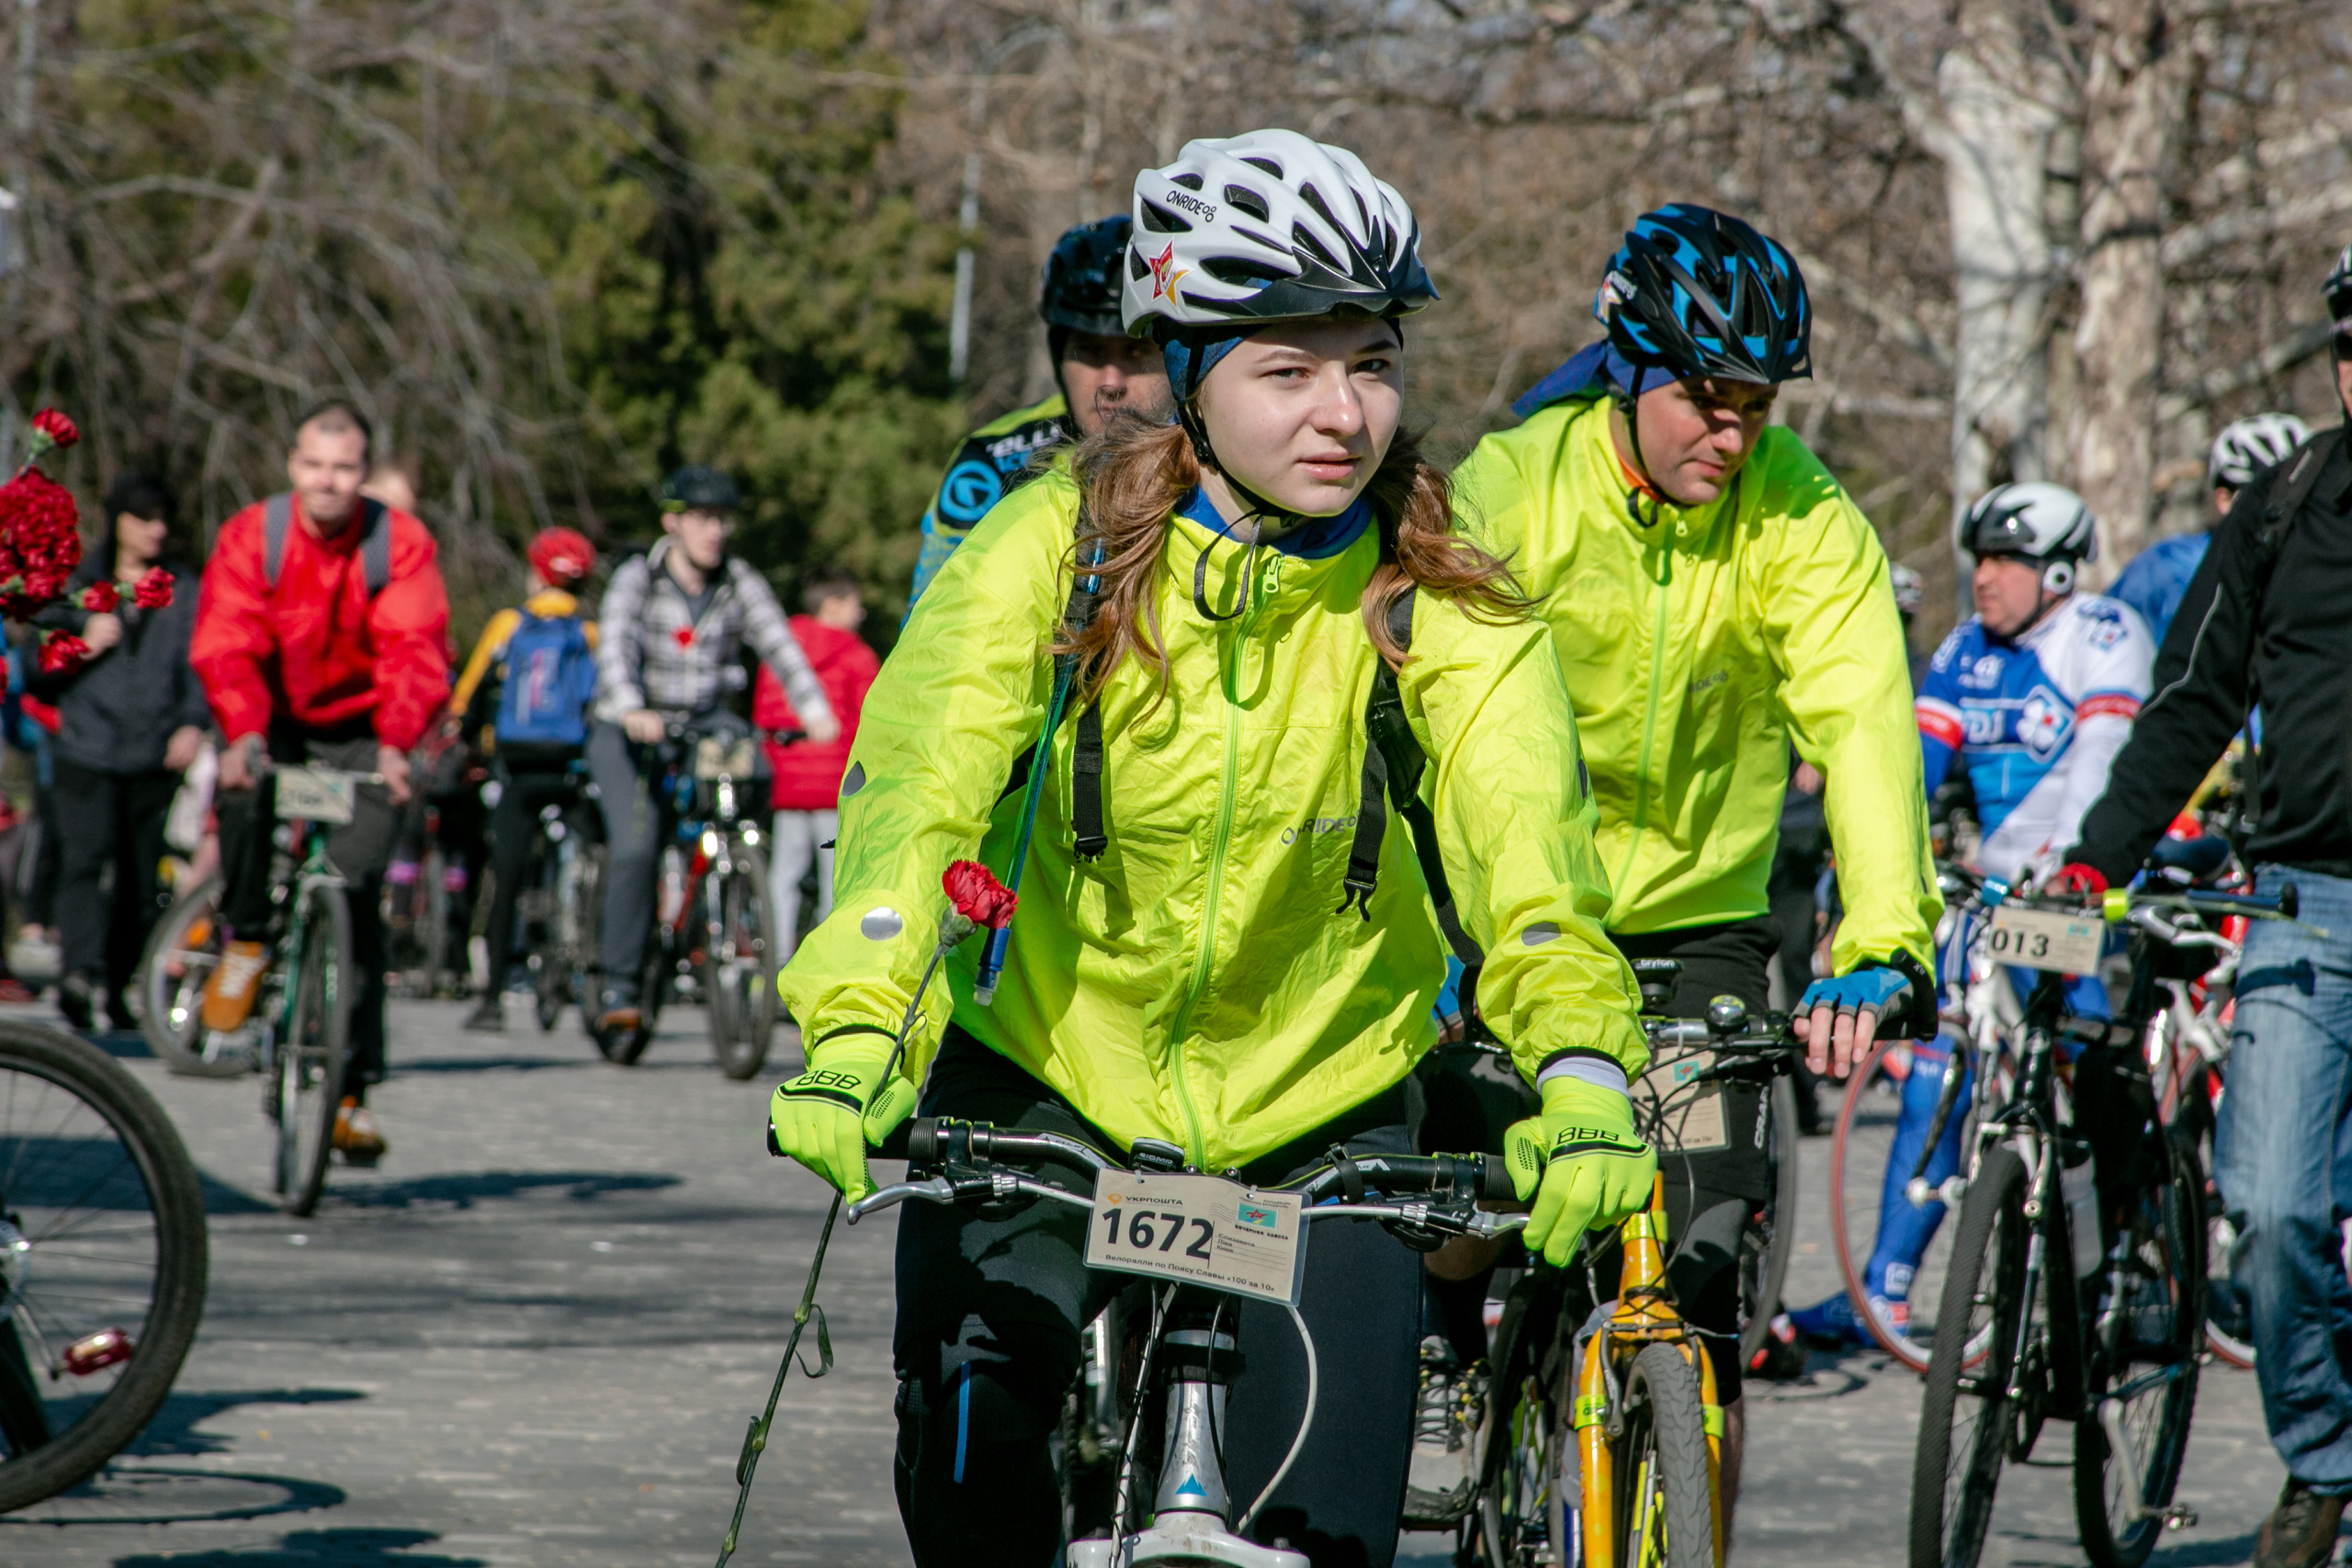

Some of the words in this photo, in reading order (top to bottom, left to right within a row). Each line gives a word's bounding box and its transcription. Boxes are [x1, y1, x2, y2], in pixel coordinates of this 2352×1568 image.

[1166, 190, 1205, 216] ONRIDE
[796, 1069, 862, 1090] BBB
[1557, 1126, 1620, 1145] BBB
[1139, 1152, 1173, 1165] SIGMA
[1125, 1196, 1183, 1206] УКРПОШТА
[1102, 1208, 1214, 1260] 1672
[1267, 1232, 1289, 1240] ОДЕССА
[1105, 1254, 1153, 1266] Велоралли
[1168, 1263, 1194, 1275] Поясу
[1196, 1269, 1225, 1280] Славы
[1227, 1276, 1247, 1285] «100
[1261, 1283, 1275, 1292] 10»
